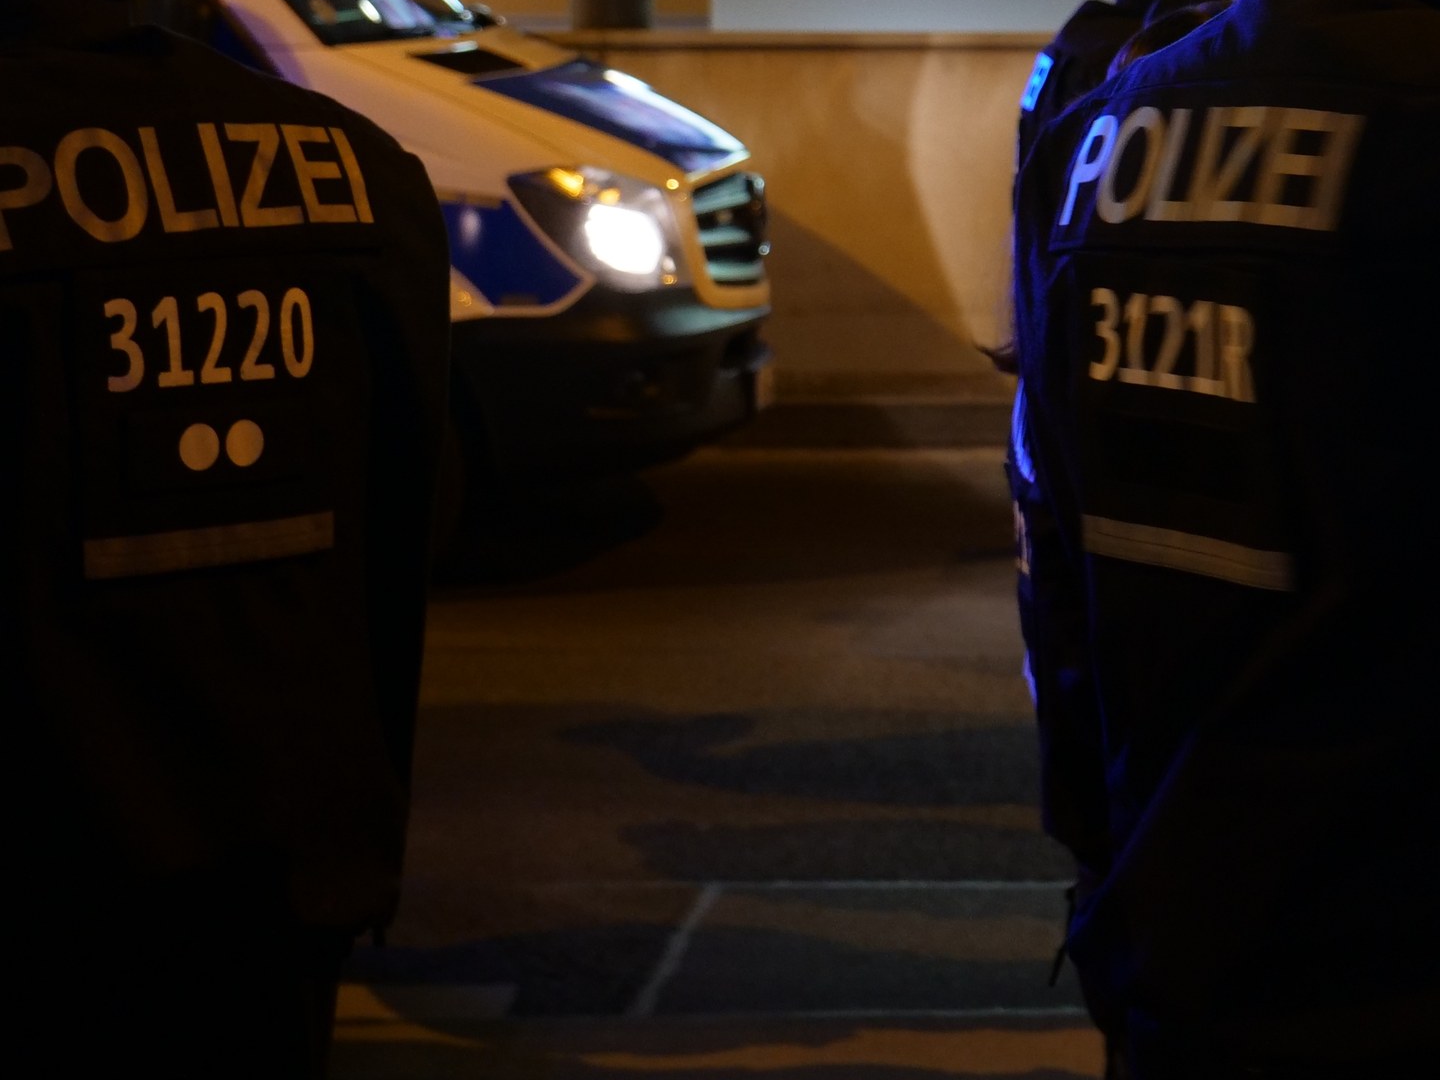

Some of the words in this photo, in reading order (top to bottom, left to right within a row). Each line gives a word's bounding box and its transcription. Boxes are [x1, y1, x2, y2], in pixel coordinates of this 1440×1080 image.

[0, 121, 375, 252] POLIZEI
[1058, 106, 1367, 232] POLIZEI
[103, 286, 315, 394] 31220
